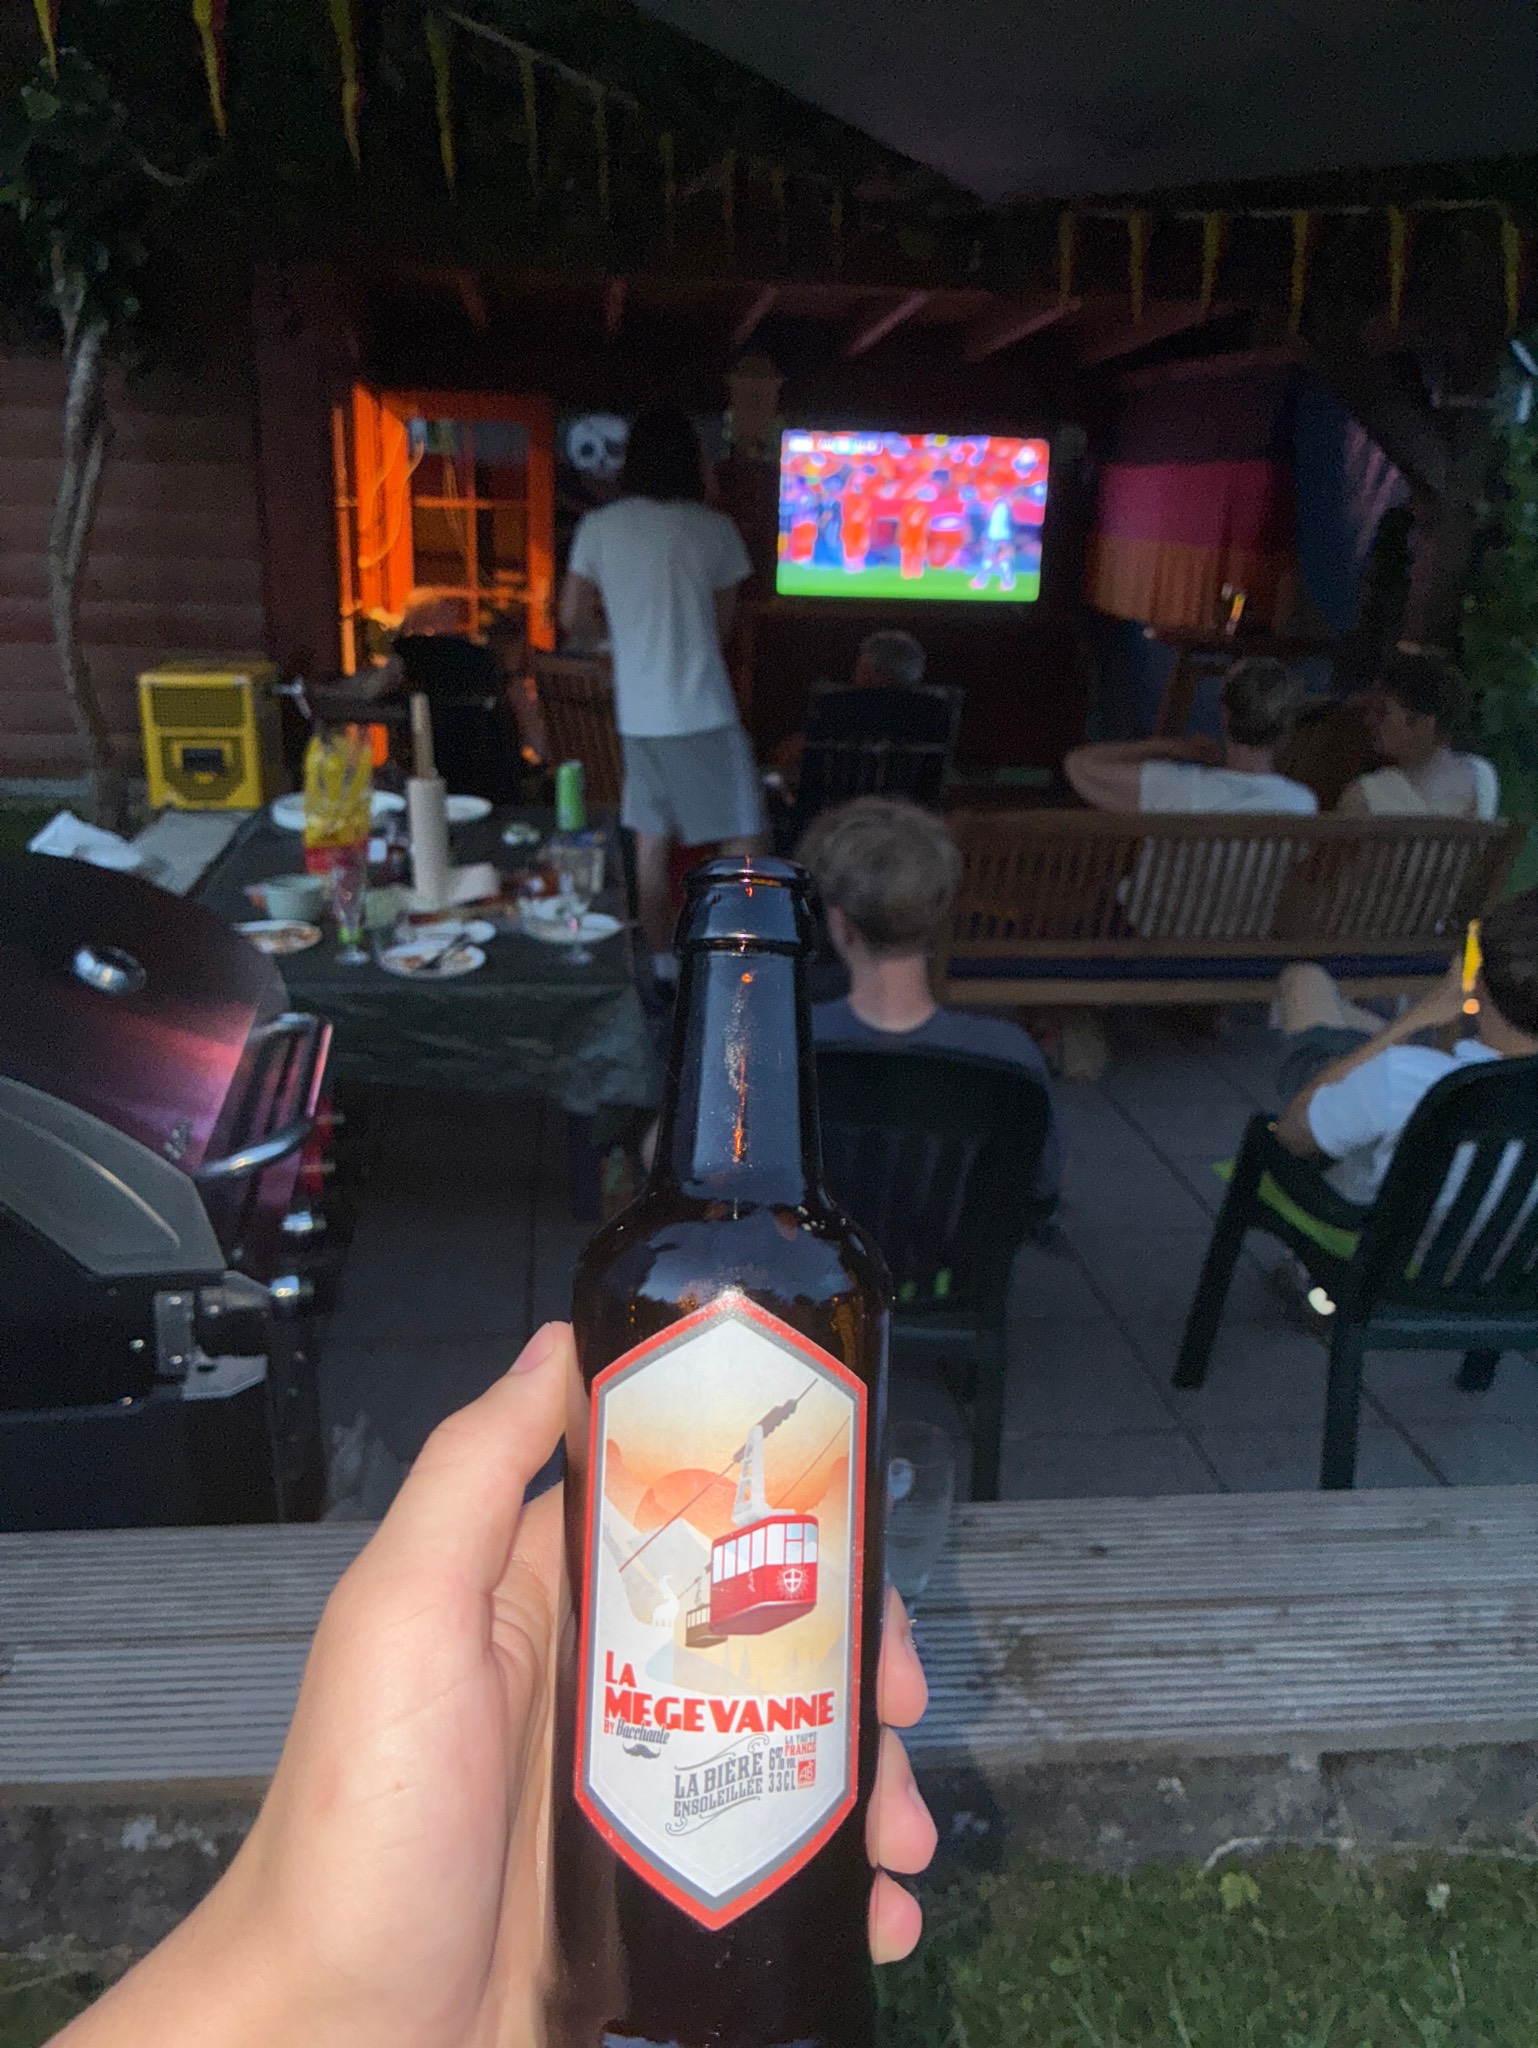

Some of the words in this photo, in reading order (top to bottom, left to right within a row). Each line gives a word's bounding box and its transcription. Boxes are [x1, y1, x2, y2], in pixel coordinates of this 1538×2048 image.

[606, 1650, 637, 1688] LA
[604, 1686, 836, 1733] MEGEVANNE
[603, 1719, 615, 1735] BY
[784, 1741, 816, 1757] FRANCE
[674, 1772, 699, 1799] LA
[703, 1751, 764, 1793] BIÈRE
[768, 1769, 796, 1793] 33CL
